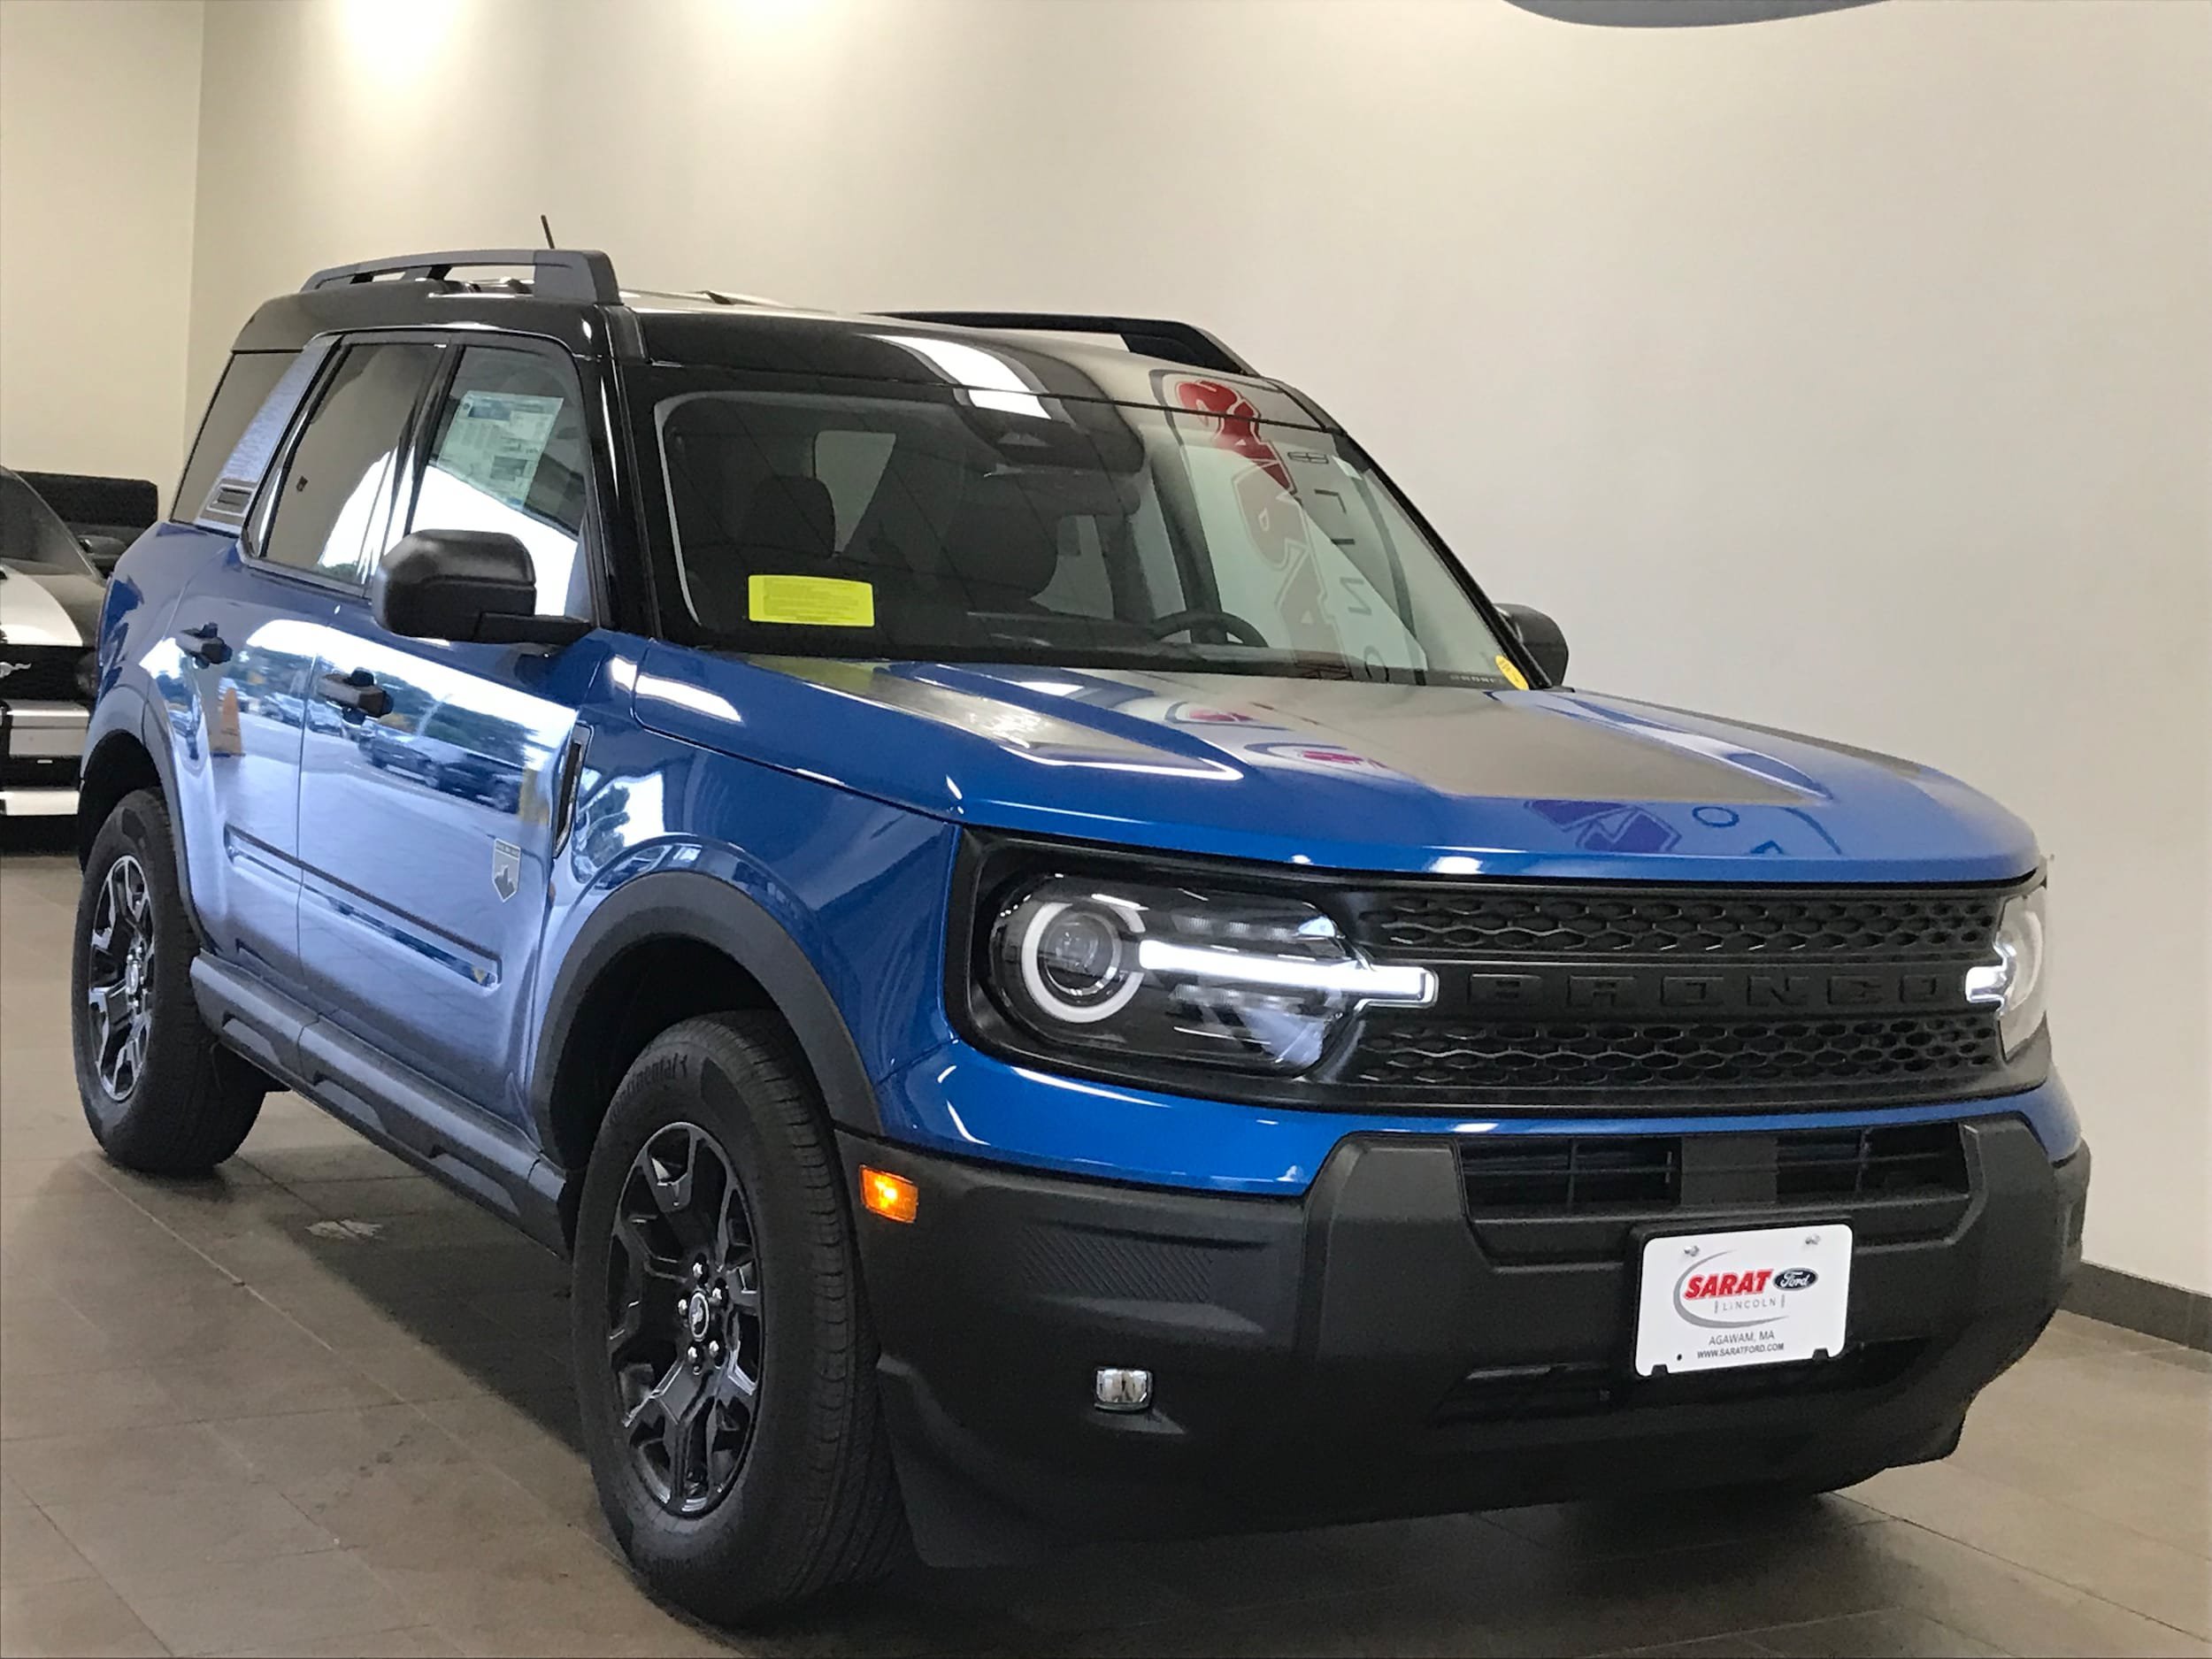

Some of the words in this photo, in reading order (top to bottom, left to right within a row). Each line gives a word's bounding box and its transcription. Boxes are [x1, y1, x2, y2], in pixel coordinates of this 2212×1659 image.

[1466, 974, 1949, 1009] BRONCO
[1684, 1269, 1774, 1299] SARAT
[1778, 1270, 1811, 1287] Ford
[1723, 1297, 1777, 1311] LINCOLN
[1709, 1331, 1755, 1347] AGAWAM,
[1759, 1330, 1775, 1340] MA
[1697, 1342, 1785, 1359] WWW.SARATFORD.COM
